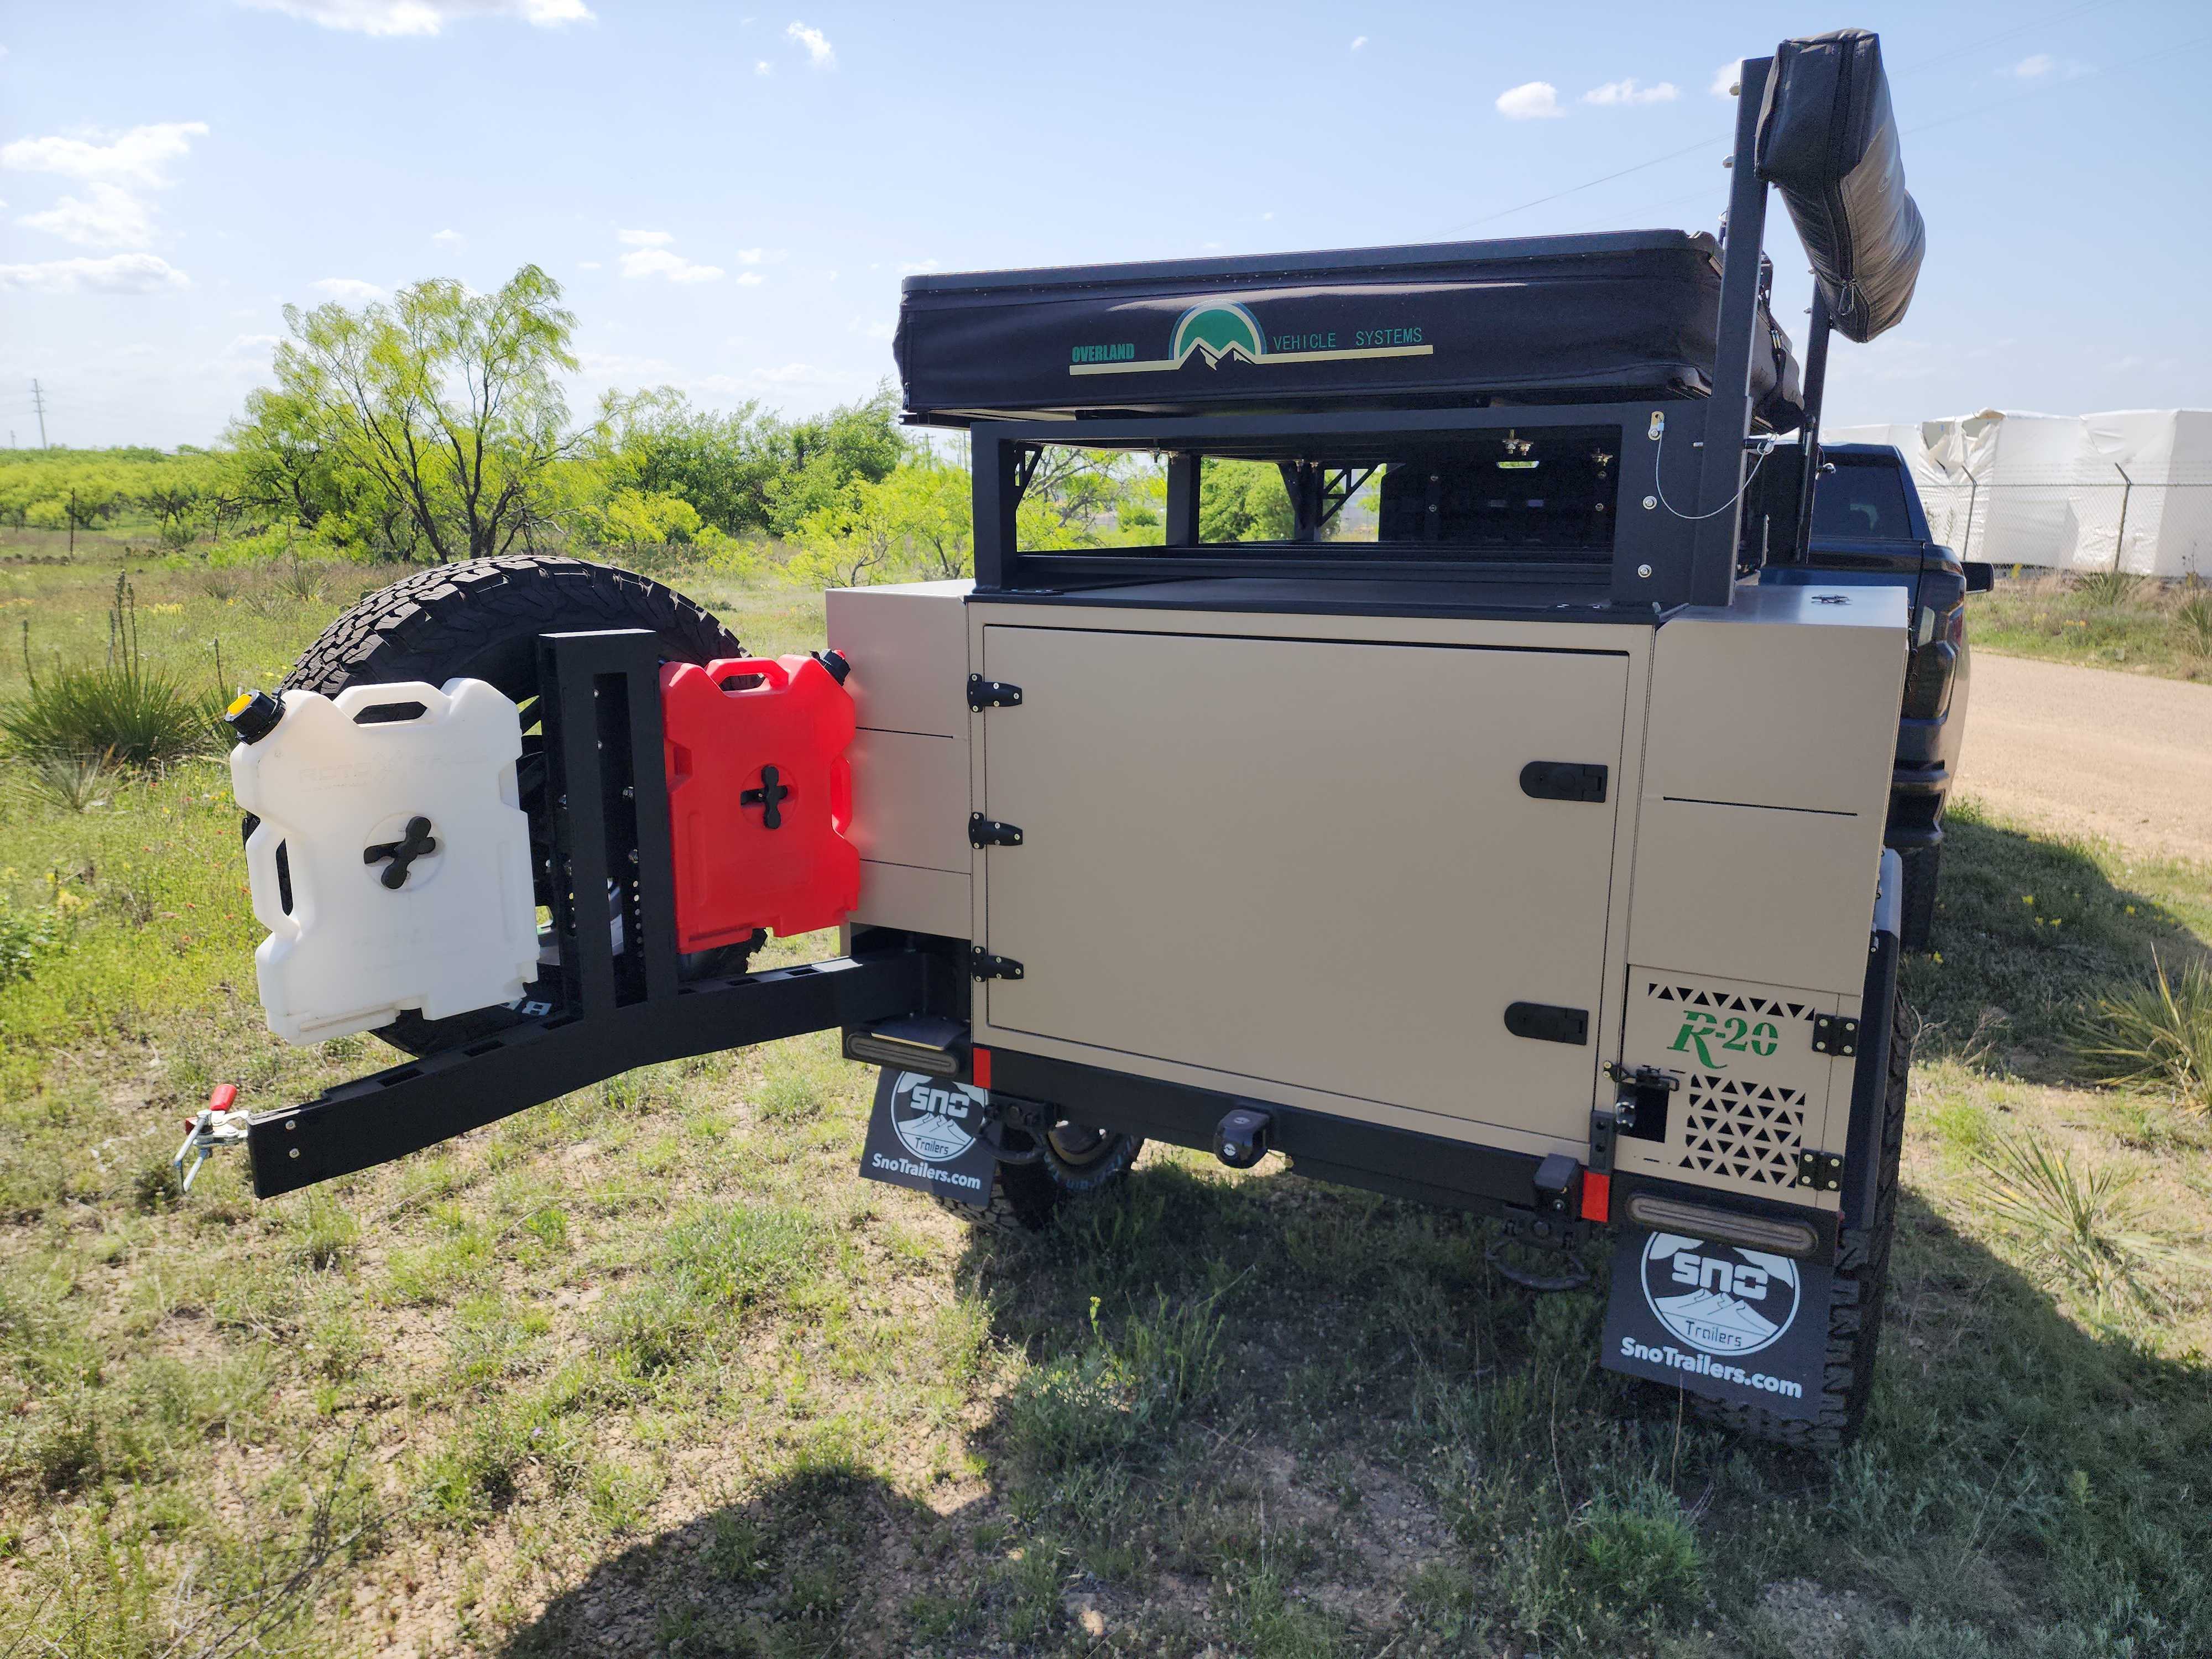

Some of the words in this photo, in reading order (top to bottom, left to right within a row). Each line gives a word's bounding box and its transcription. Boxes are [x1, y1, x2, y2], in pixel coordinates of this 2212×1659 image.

[1072, 343, 1135, 363] OVERLAND
[1273, 333, 1337, 351] VEHICLE
[1355, 327, 1423, 346] SYSTEMS
[1666, 1010, 1779, 1070] R-20
[915, 1137, 949, 1155] Trailers
[872, 1153, 981, 1190] SnoTrailers.com
[1686, 1321, 1742, 1348] Trailers
[1620, 1337, 1803, 1399] SnoTrailers.com
